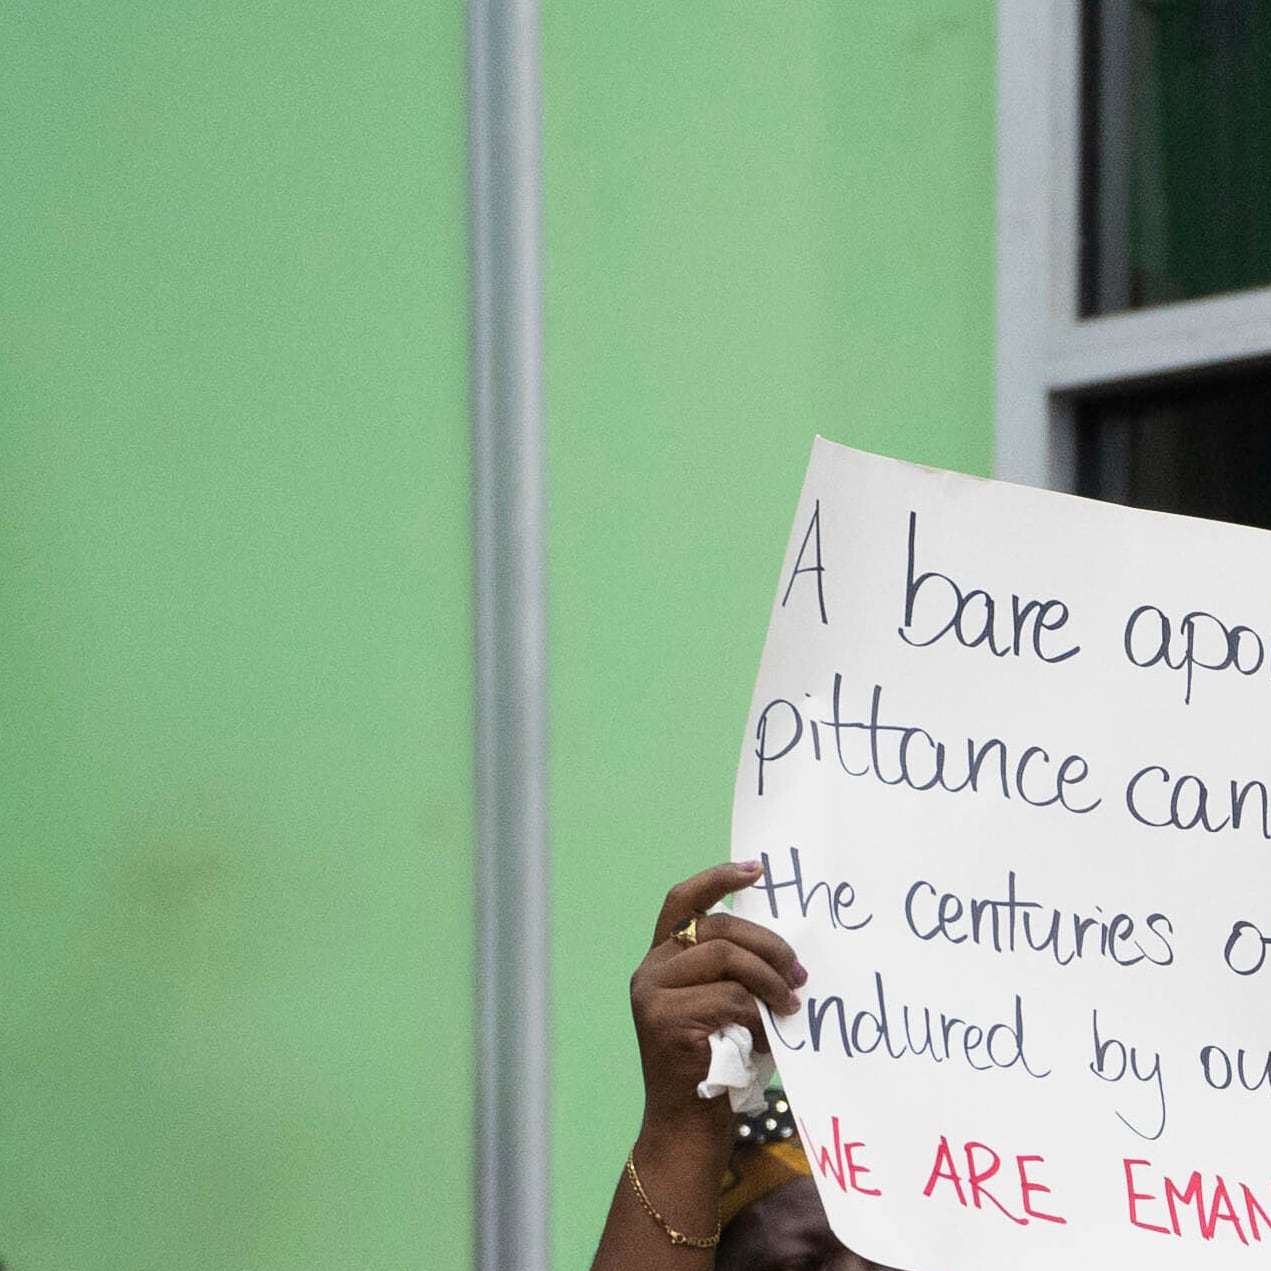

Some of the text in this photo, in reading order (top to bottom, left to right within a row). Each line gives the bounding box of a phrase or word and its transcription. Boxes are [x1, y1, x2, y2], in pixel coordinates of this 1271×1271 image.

[782, 500, 828, 625] A
[898, 511, 1081, 663] bare
[755, 673, 1102, 813] pittance
[755, 847, 873, 936] the
[905, 872, 1174, 966] centuries
[1090, 1009, 1166, 1140] by
[800, 1114, 883, 1198] WE
[923, 1135, 1067, 1226] ARE
